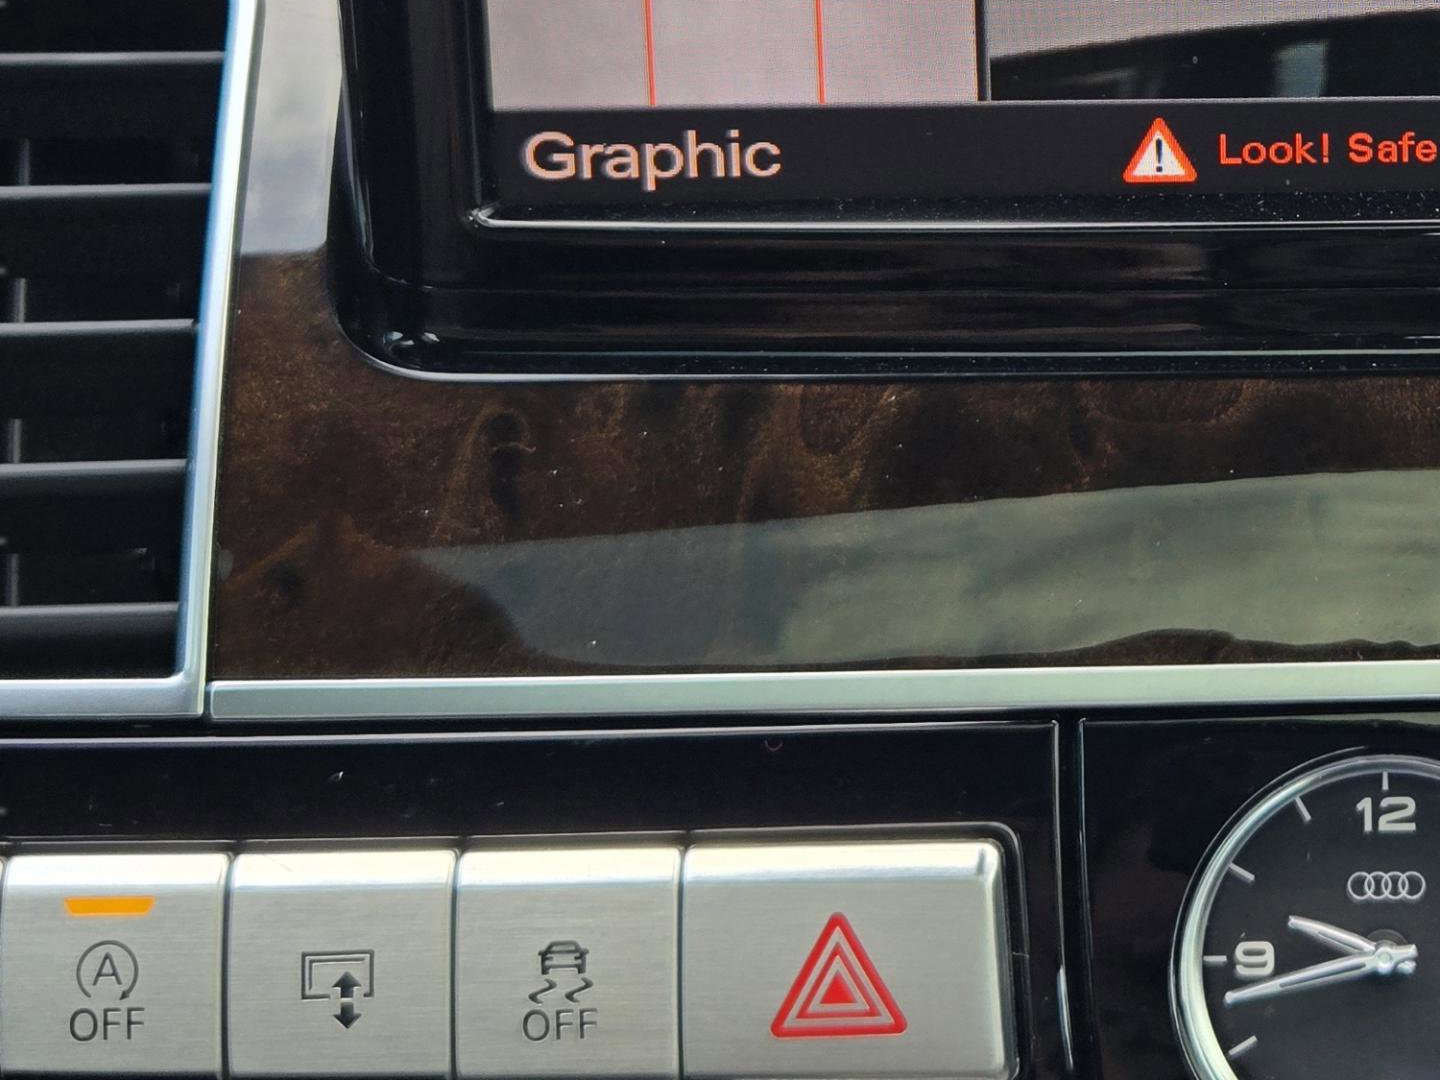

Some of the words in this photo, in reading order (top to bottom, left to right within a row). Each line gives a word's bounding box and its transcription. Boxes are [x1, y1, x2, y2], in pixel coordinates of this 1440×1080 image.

[522, 129, 782, 191] Graphic
[1219, 133, 1330, 164] Look!
[1348, 132, 1438, 163] Safe
[1356, 796, 1417, 833] 12
[1234, 940, 1275, 975] 9
[69, 1007, 145, 1042] OFF
[522, 1008, 598, 1042] OFF
